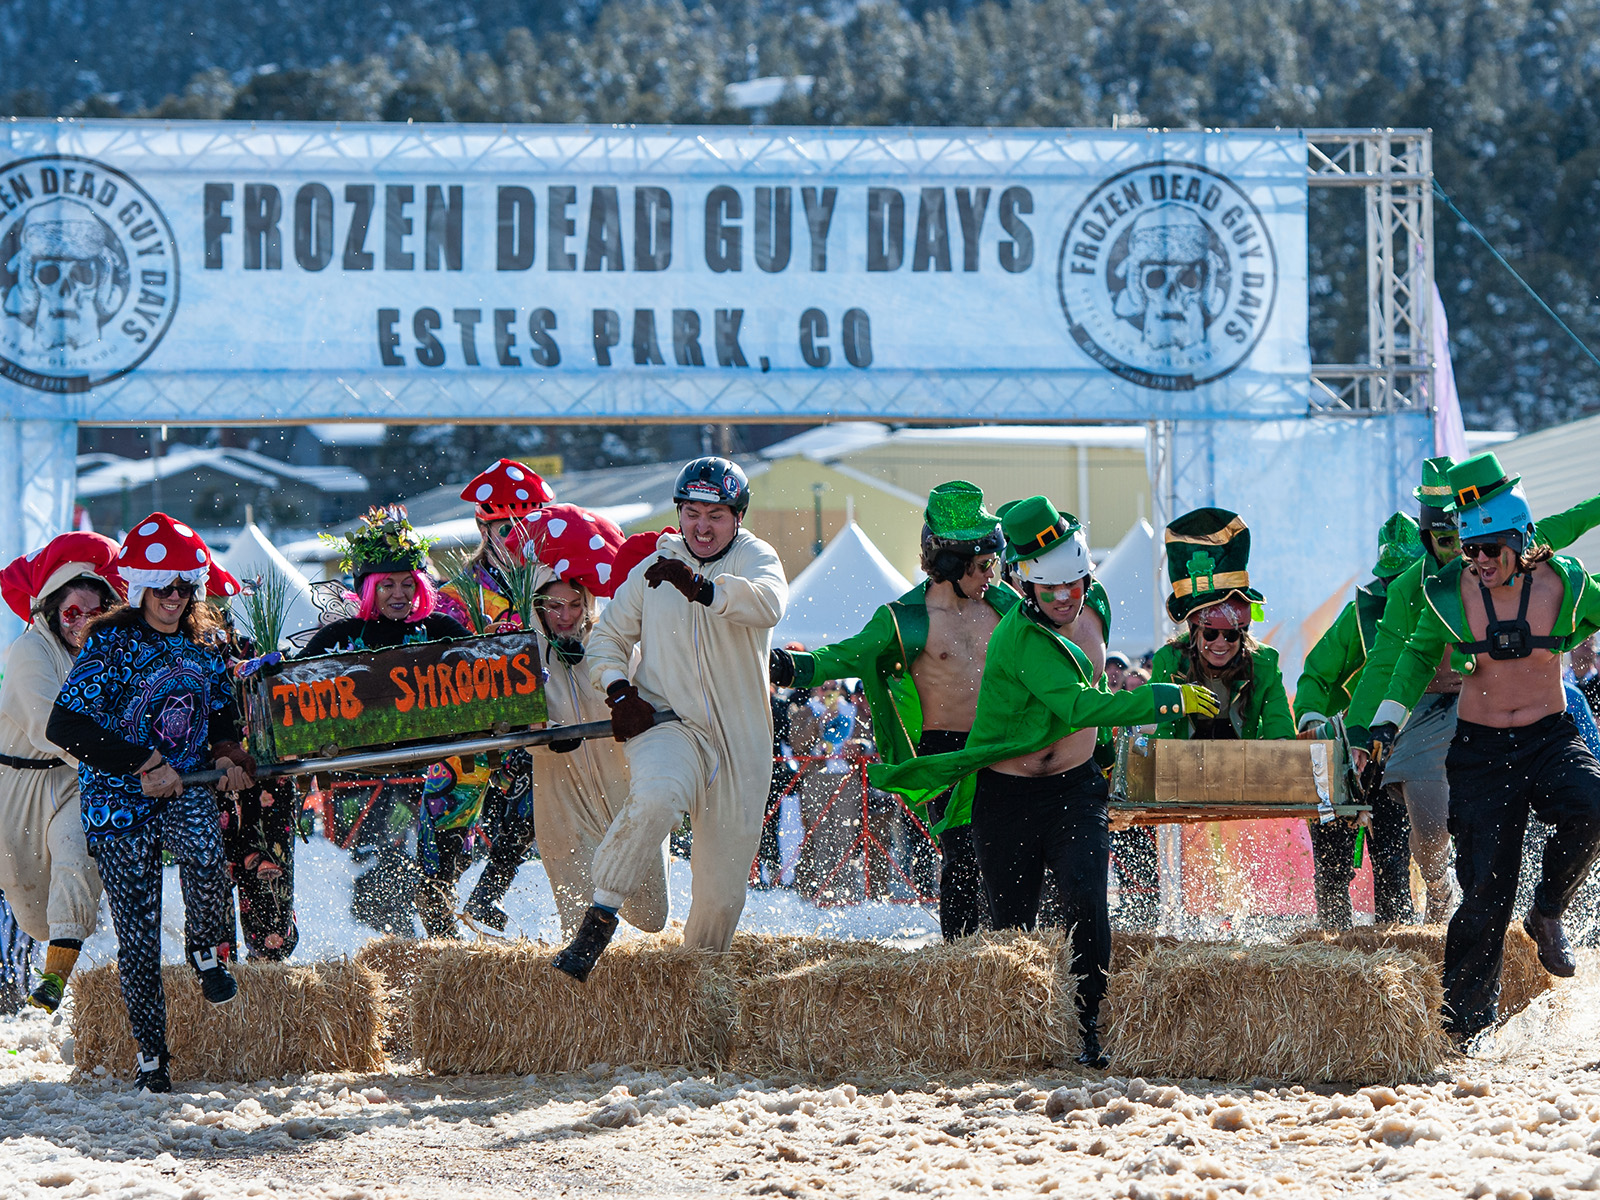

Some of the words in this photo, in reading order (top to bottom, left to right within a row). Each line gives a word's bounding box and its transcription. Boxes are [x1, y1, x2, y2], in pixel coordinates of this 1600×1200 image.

[39, 167, 119, 208] DEAD
[1149, 173, 1223, 212] DEAD
[117, 200, 166, 257] GUY
[203, 182, 464, 272] FROZEN
[496, 185, 673, 272] DEAD
[704, 184, 839, 274] GUY
[866, 185, 1036, 274] DAYS
[1070, 180, 1144, 275] FROZEN
[1220, 205, 1265, 260] GUY
[120, 268, 168, 344] DAYS
[377, 306, 562, 368] ESTES
[592, 308, 770, 373] PARK,
[799, 307, 874, 369] CO
[1224, 271, 1266, 345] DAYS
[272, 675, 364, 727] TOMB
[389, 652, 536, 713] SHROOMS
